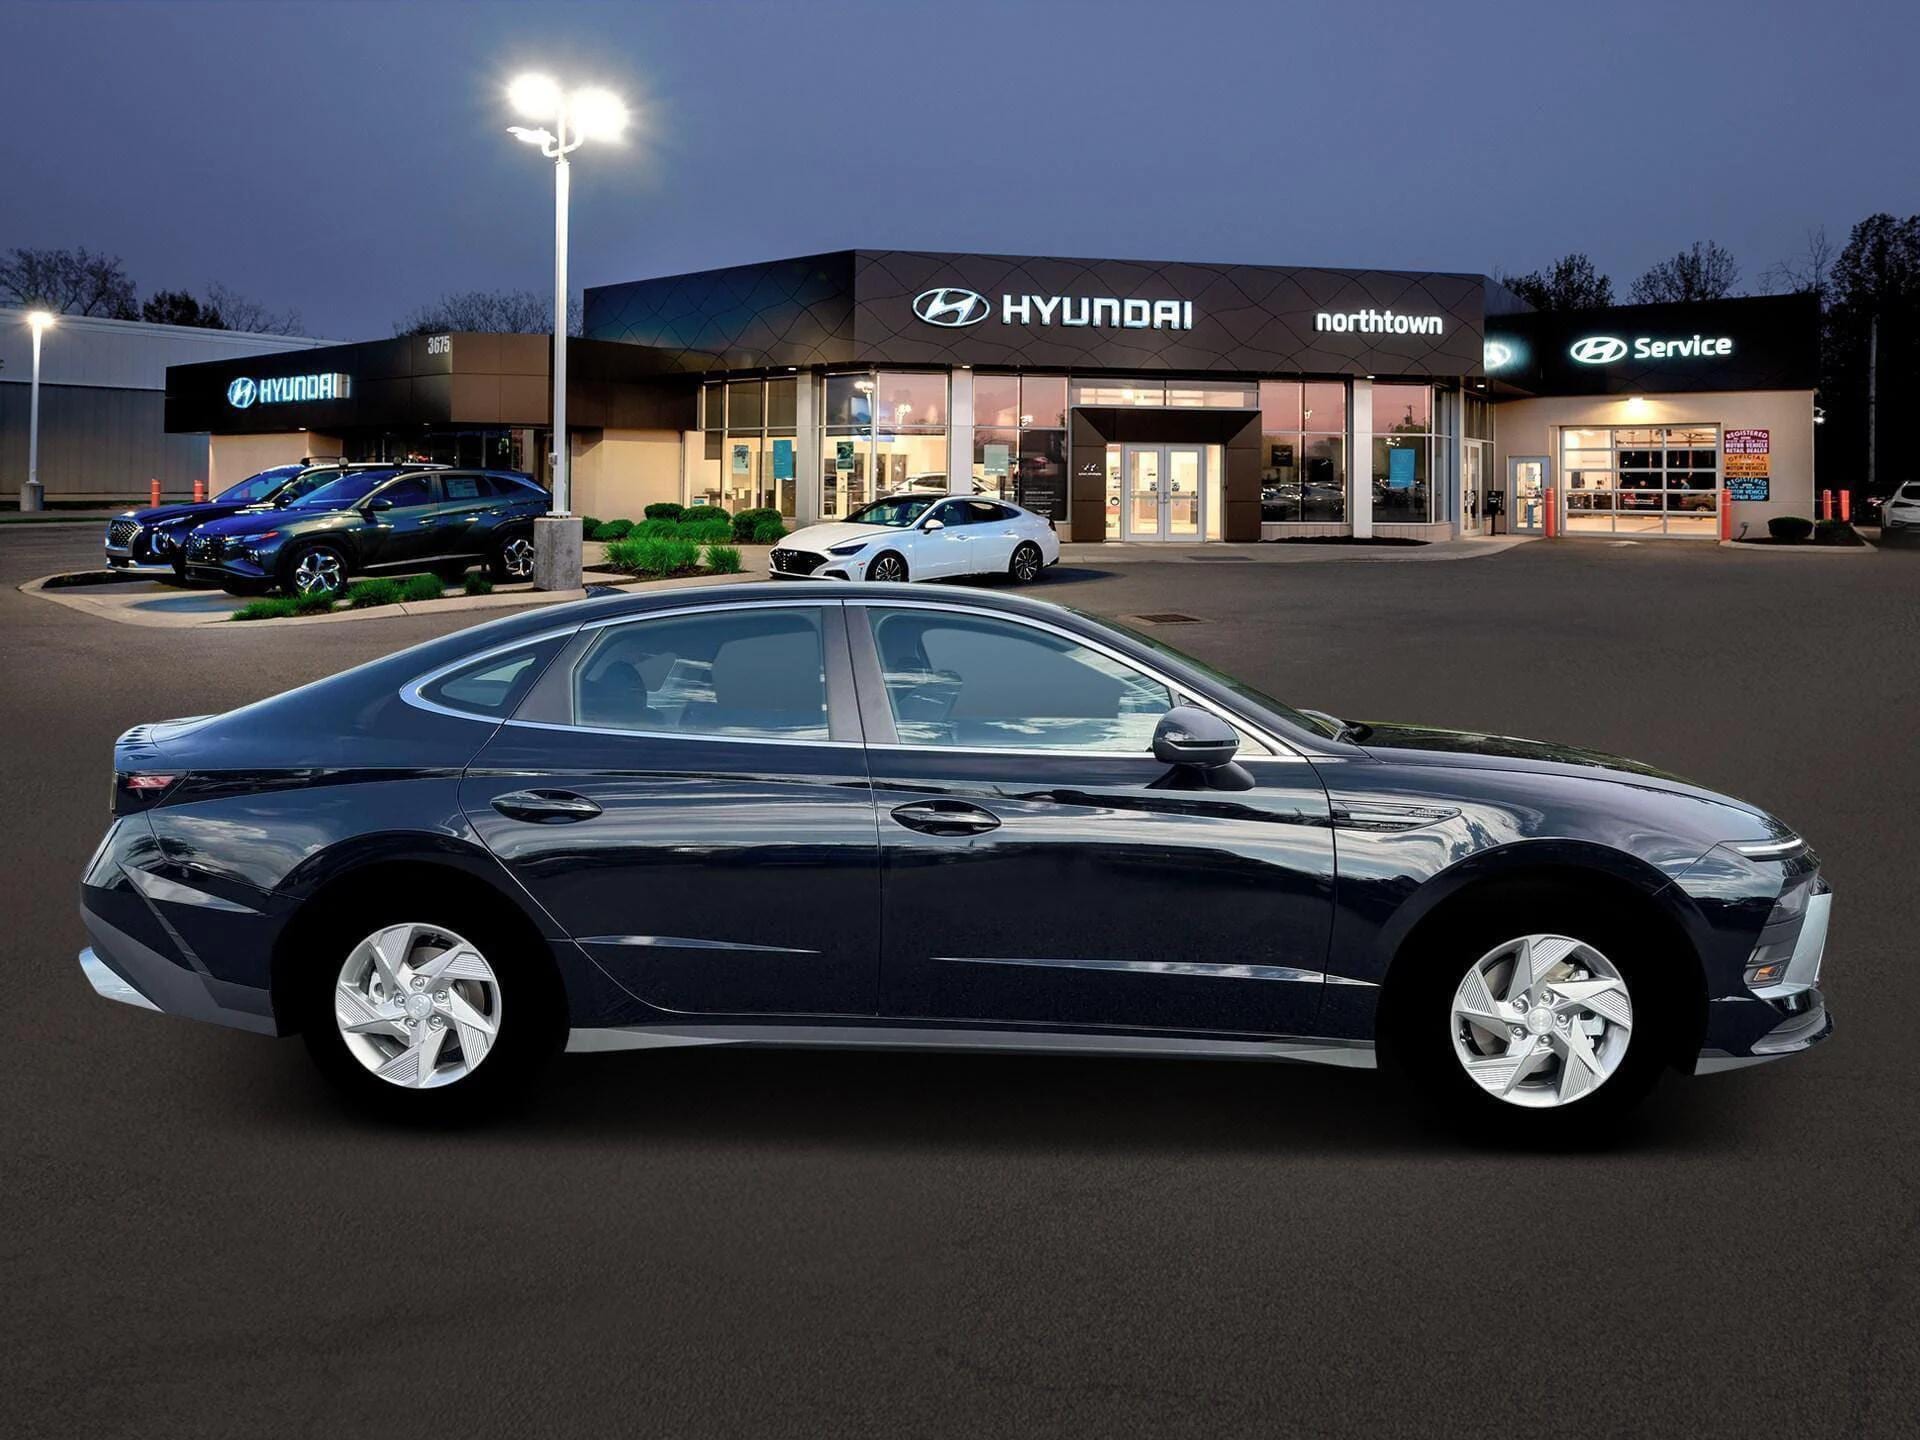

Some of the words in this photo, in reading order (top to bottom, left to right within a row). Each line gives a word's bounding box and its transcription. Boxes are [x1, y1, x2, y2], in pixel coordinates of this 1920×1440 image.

[1002, 294, 1193, 329] HYUNDAI
[1315, 309, 1444, 335] northtown
[428, 335, 450, 354] 3675
[1633, 335, 1733, 359] Service
[259, 372, 344, 404] HYUNDAI
[1726, 430, 1768, 439] REGISTERED
[1728, 454, 1766, 462] OFFICIAL
[1726, 477, 1767, 486] REGISTERED
